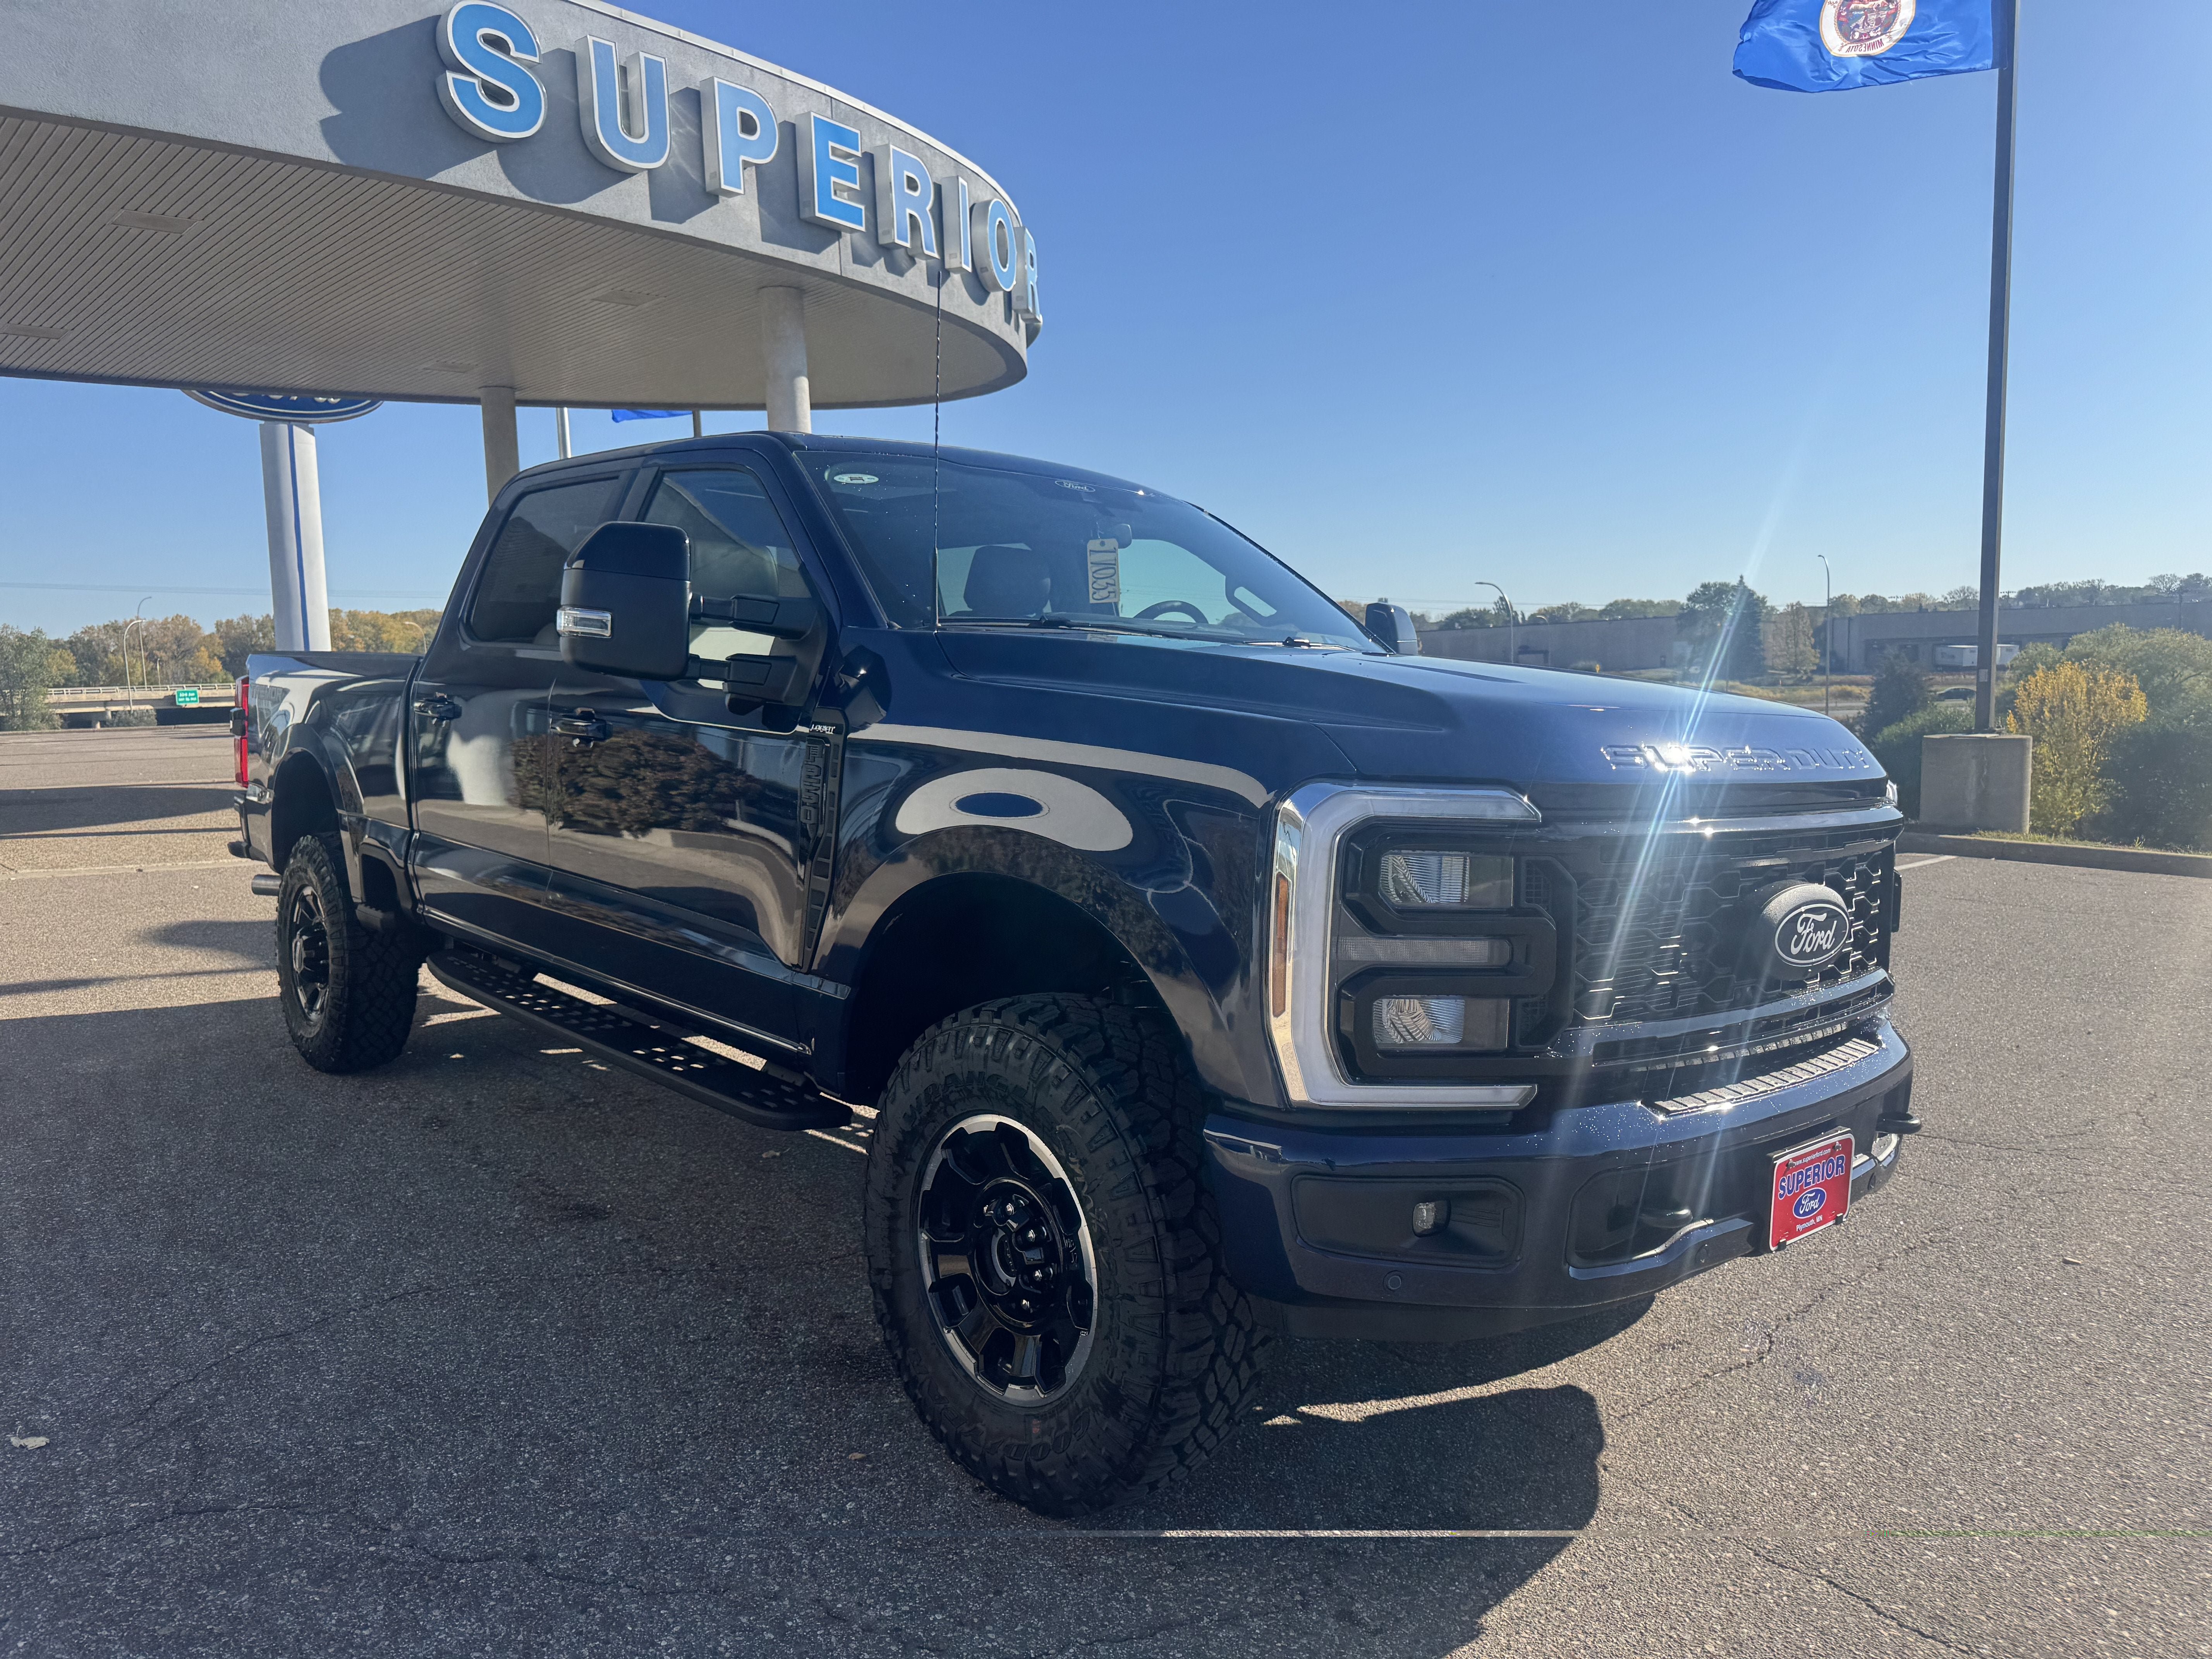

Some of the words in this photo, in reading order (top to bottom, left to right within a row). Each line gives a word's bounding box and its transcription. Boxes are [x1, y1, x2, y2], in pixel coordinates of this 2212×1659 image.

[436, 0, 1042, 322] SUPERIOR
[1600, 744, 1791, 771] SUPER
[1790, 912, 1838, 955] Ford
[1778, 1154, 1845, 1200] SUPERIOR
[1799, 1192, 1820, 1214] Ford
[1816, 1214, 1823, 1223] MN
